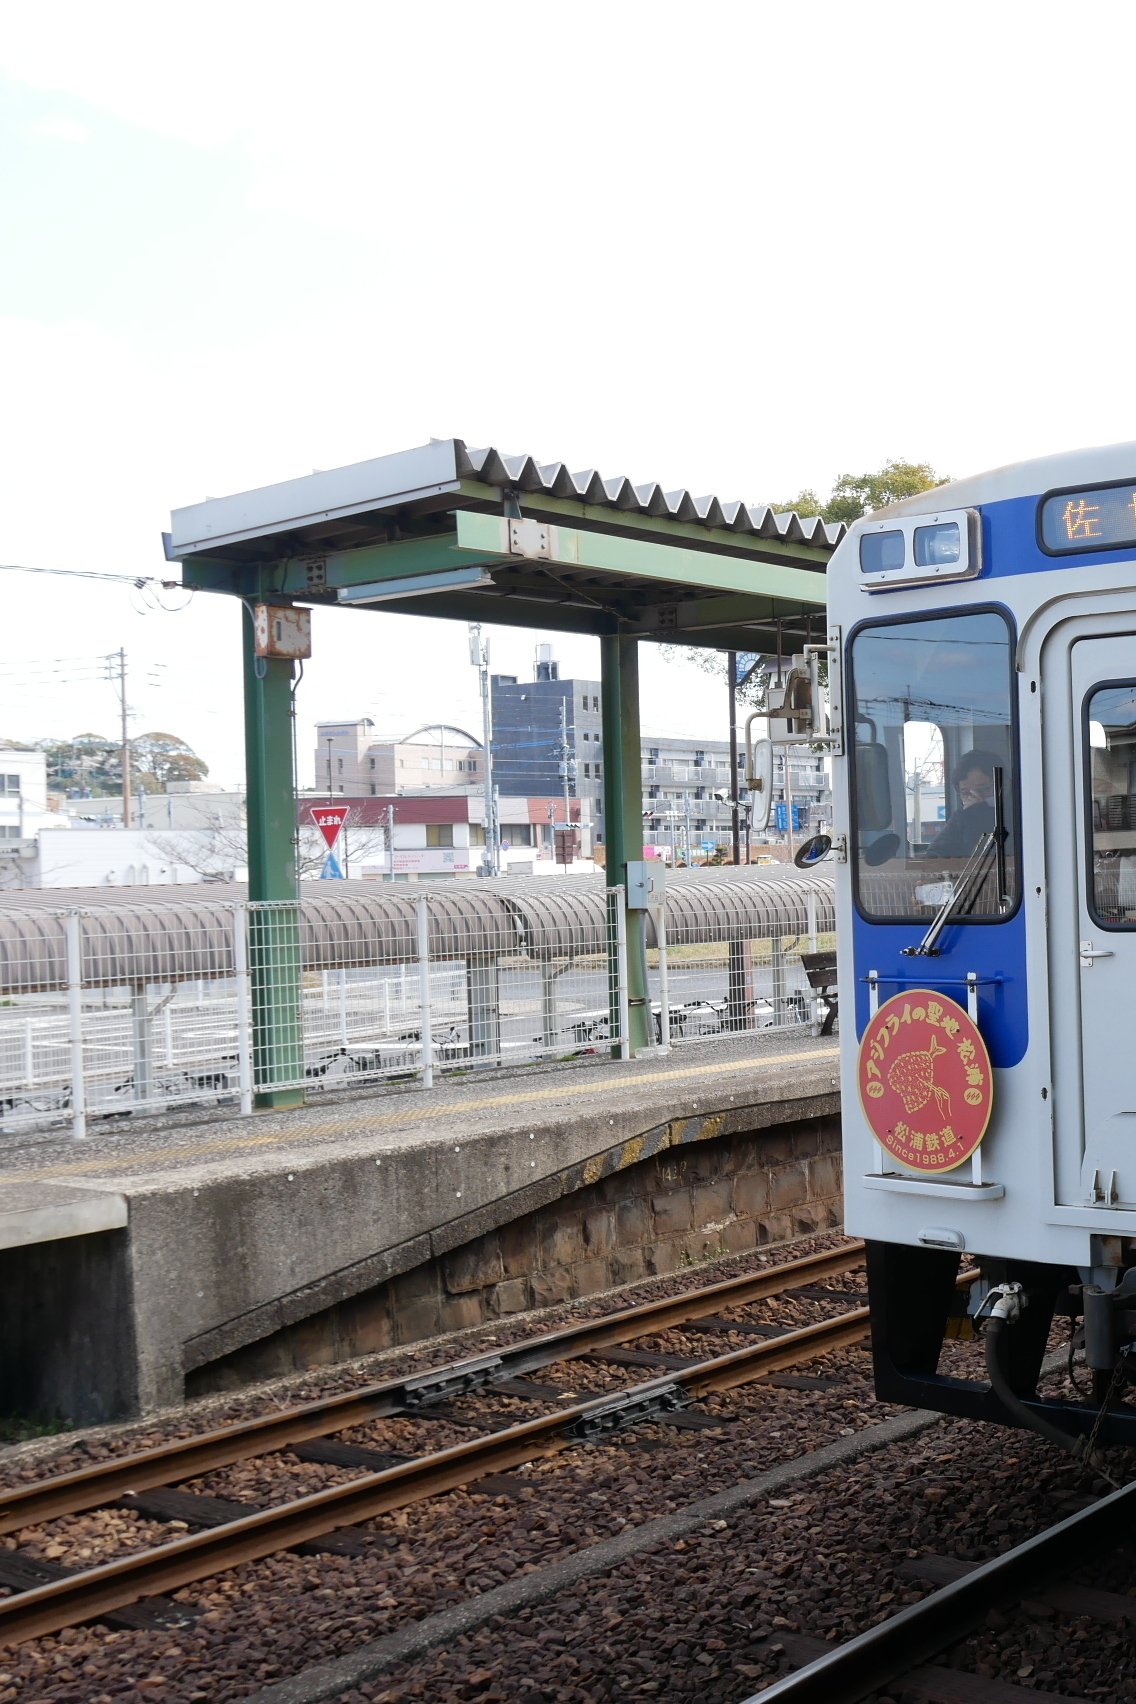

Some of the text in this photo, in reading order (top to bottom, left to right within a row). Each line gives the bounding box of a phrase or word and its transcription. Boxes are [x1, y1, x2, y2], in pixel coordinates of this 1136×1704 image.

[318, 815, 342, 826] 止まれ
[866, 1001, 984, 1087] アジフライの聖地 松浦
[894, 1121, 957, 1152] 松浦鉄道
